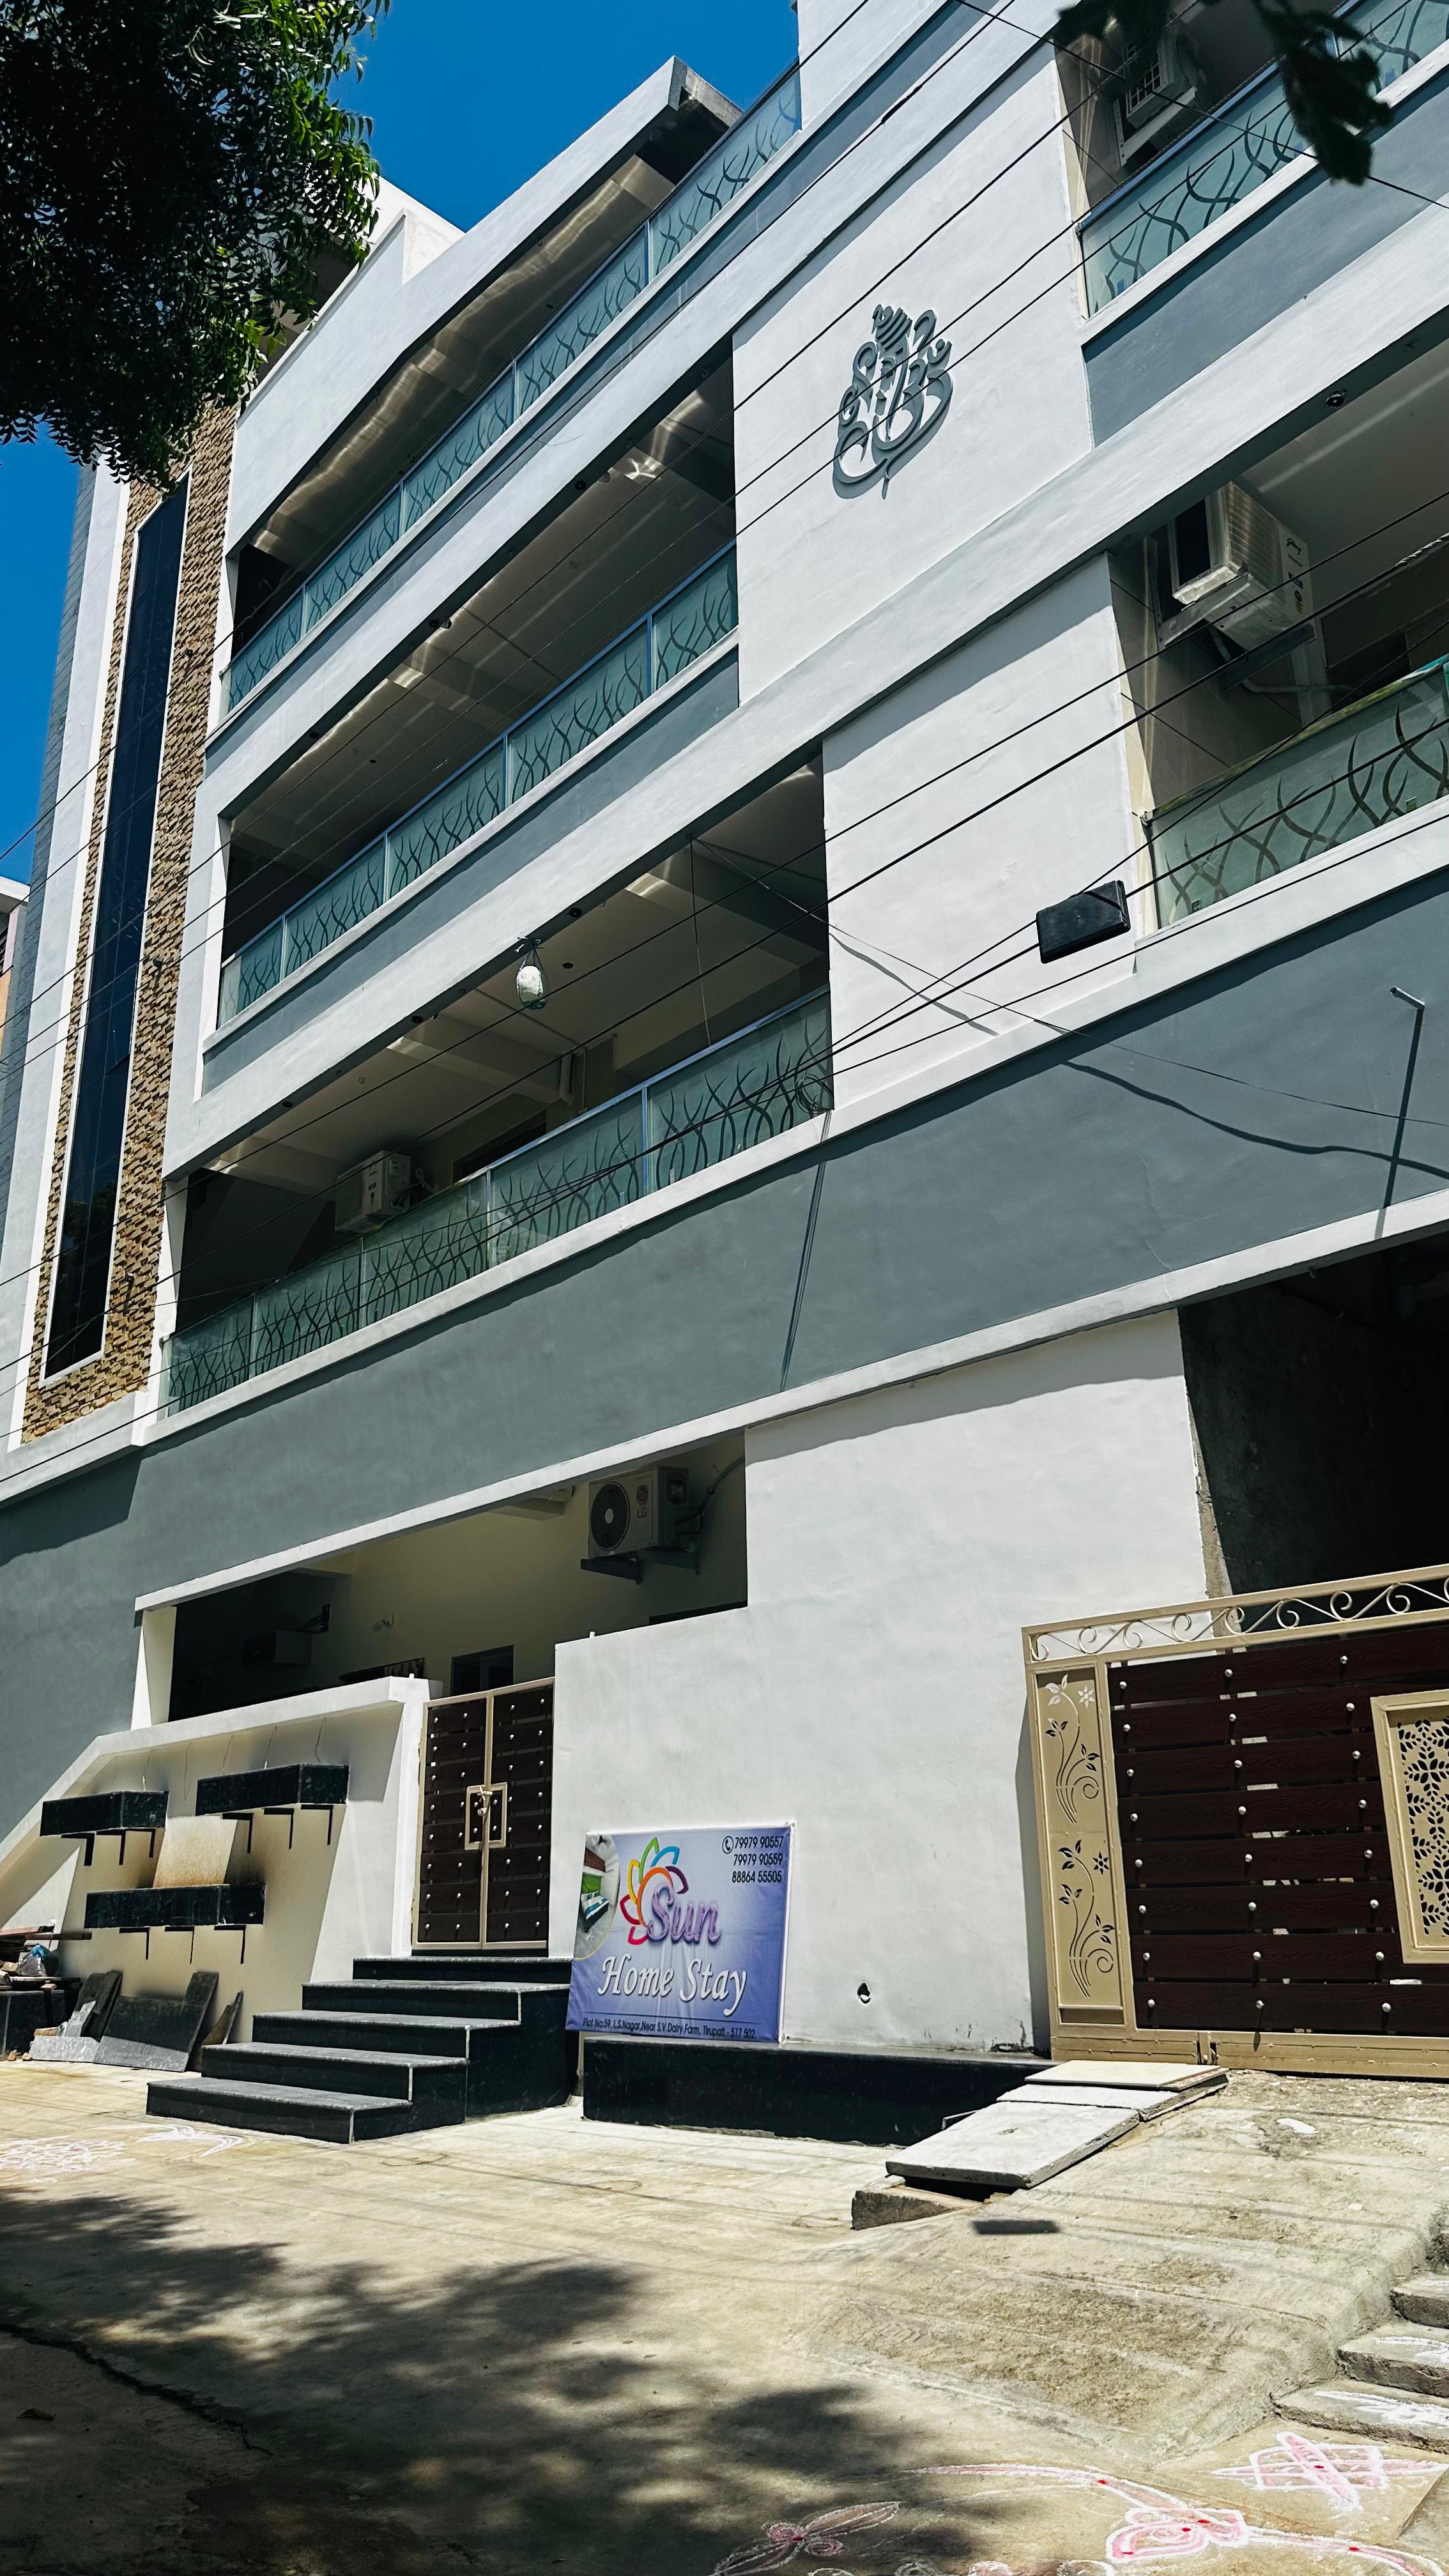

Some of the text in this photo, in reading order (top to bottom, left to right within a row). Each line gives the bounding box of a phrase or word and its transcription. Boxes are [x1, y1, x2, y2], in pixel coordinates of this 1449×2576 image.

[637, 1507, 647, 1519] LG
[735, 1836, 784, 1849] 79979 90557
[733, 1853, 783, 1866] 79979 90559
[732, 1870, 782, 1883] 88864 55505
[647, 1884, 721, 1943] Sun
[597, 1952, 747, 2016] Home Stay
[703, 2025, 726, 2037] Tirupati
[730, 2027, 742, 2038] 517
